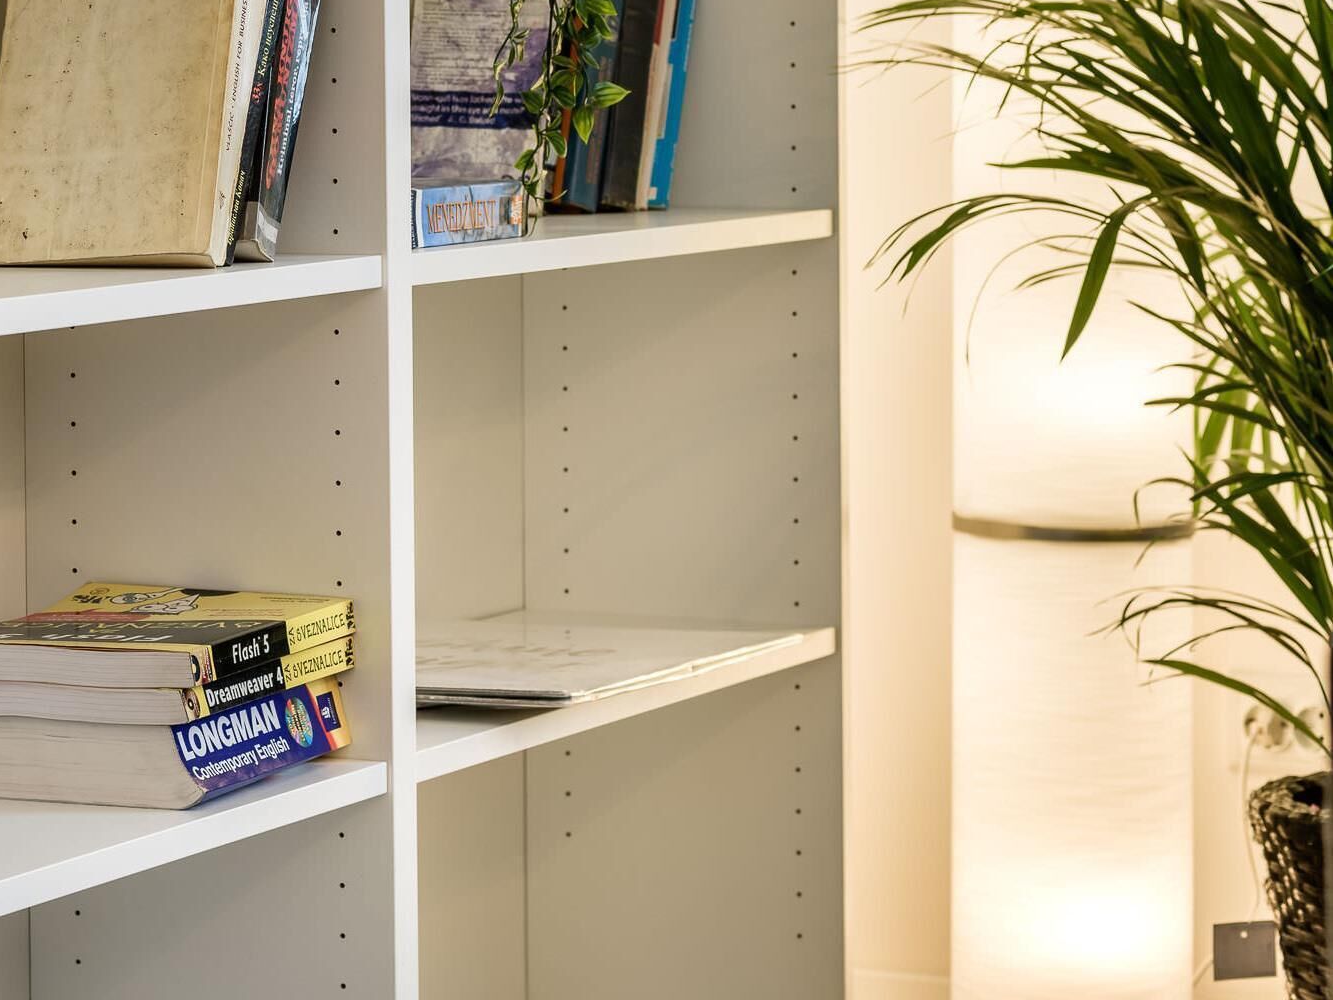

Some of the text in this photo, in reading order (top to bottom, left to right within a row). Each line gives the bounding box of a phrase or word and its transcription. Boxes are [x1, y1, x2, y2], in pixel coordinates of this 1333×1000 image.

[231, 61, 241, 103] ENGLISH
[237, 40, 245, 58] FOR
[43, 631, 173, 643] Flash
[296, 612, 345, 642] SVEZNALICE
[232, 634, 271, 664] Flash 5
[293, 649, 344, 679] SVEZNALICE
[206, 666, 284, 708] Dreamweaver 4
[176, 700, 282, 762] LONGMAN
[192, 736, 291, 781] Contemporary English
